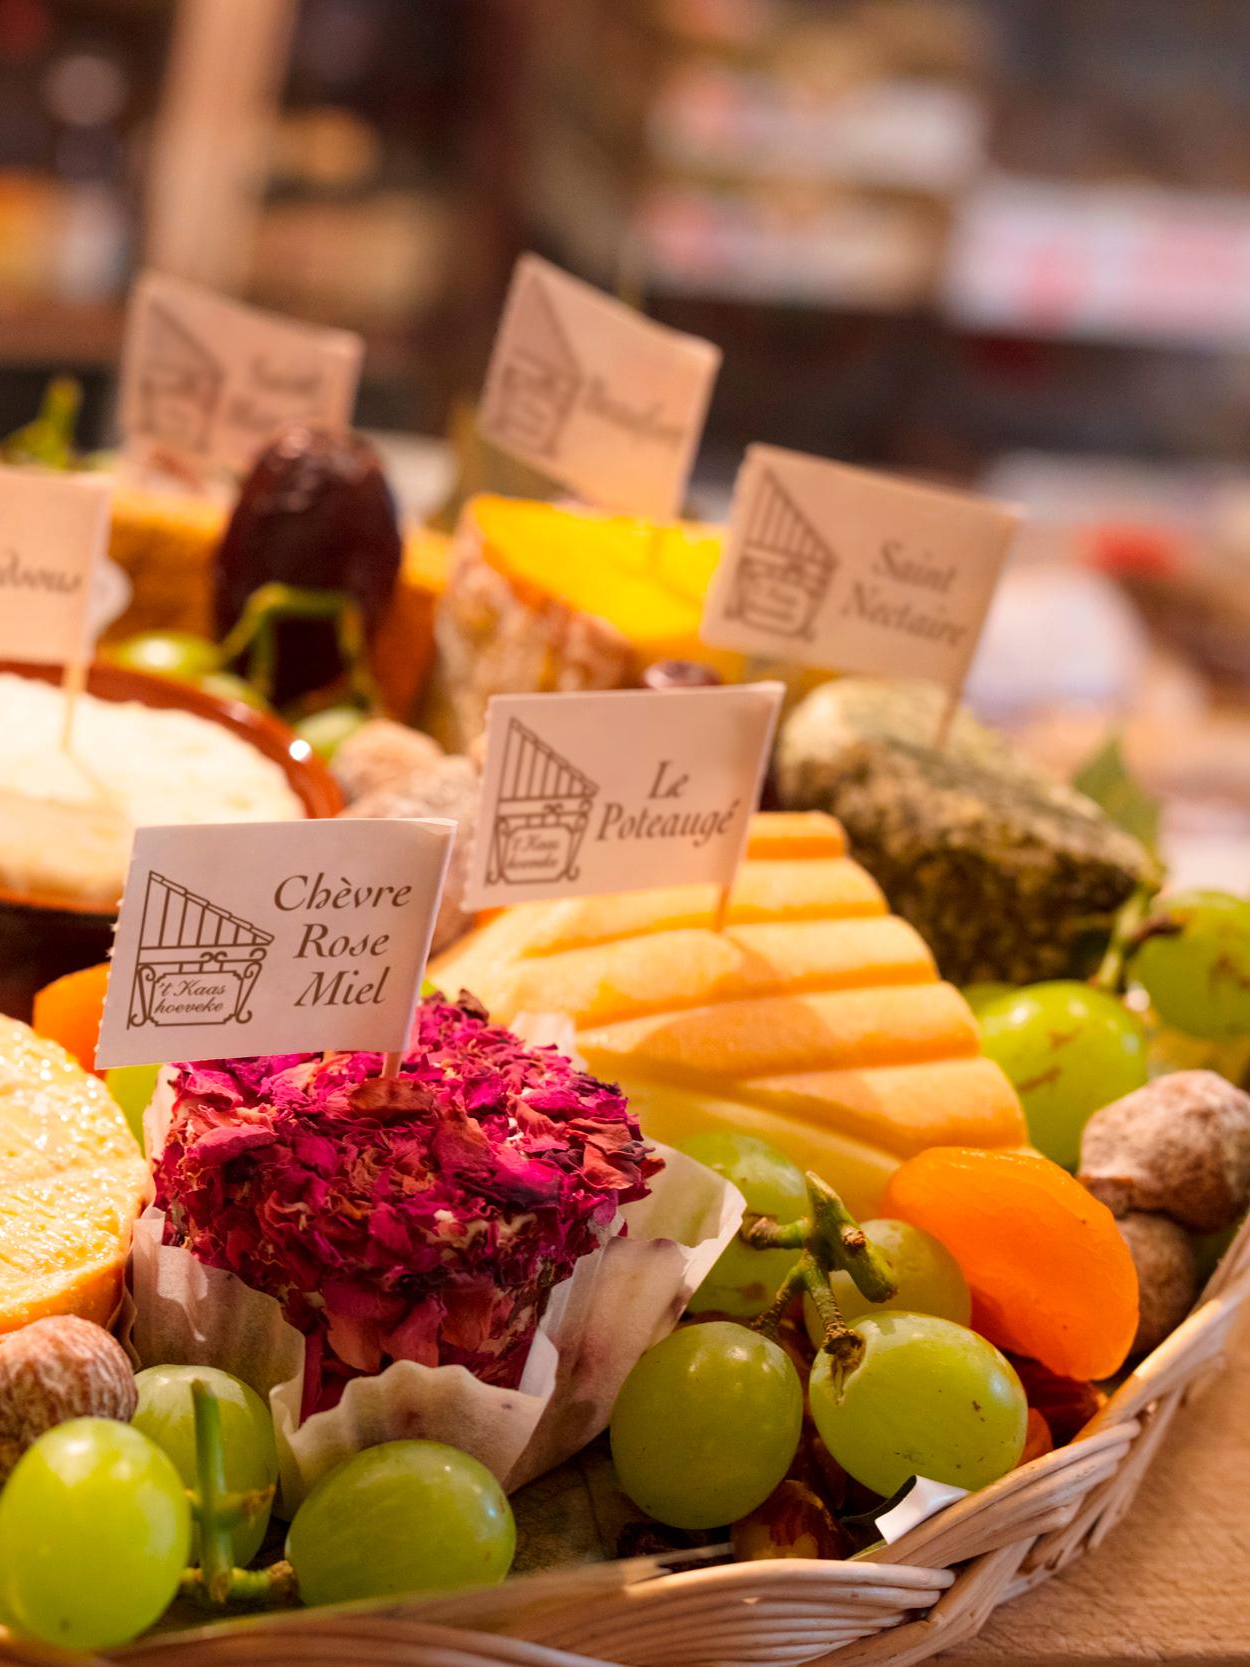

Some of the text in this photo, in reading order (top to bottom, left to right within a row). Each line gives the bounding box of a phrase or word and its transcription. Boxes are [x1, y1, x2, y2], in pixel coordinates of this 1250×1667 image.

[871, 540, 958, 593] Saint
[840, 581, 967, 647] Nectaire
[647, 760, 690, 801] Le
[595, 797, 742, 848] Poteaugé
[273, 871, 412, 912] Chèvre
[293, 922, 390, 959] Rose
[154, 997, 224, 1014] hoeveke
[173, 979, 227, 997] Kaas
[294, 966, 391, 1007] Miel
